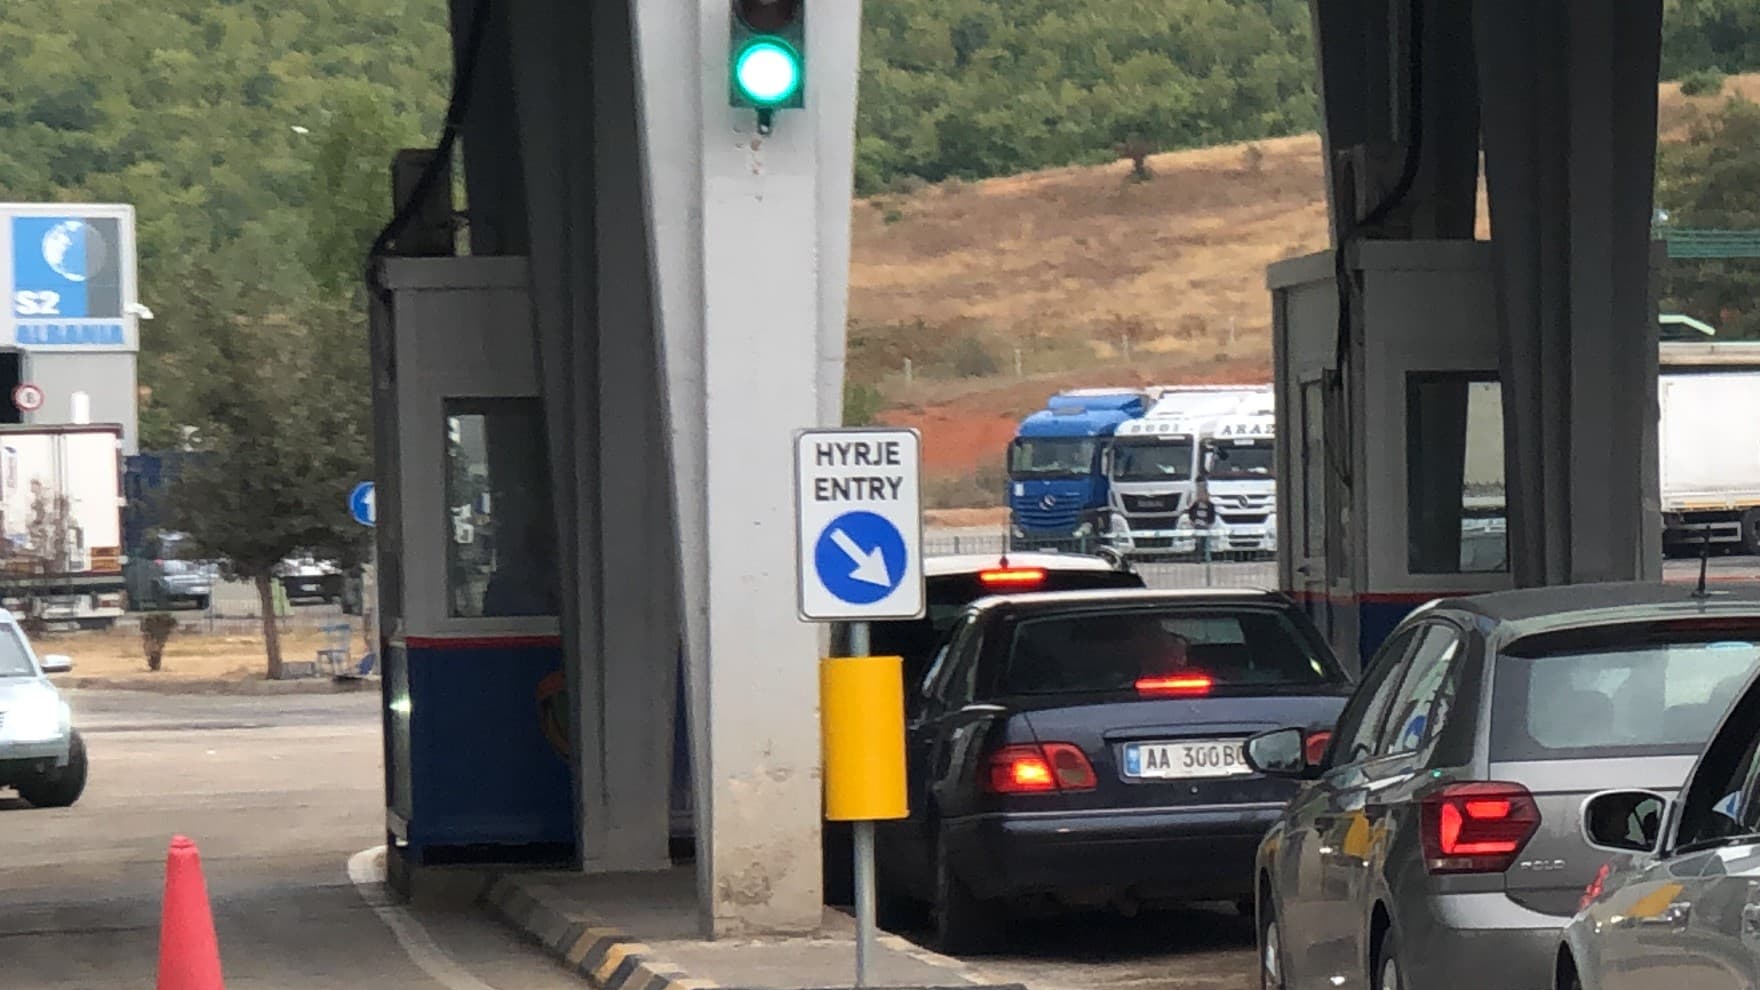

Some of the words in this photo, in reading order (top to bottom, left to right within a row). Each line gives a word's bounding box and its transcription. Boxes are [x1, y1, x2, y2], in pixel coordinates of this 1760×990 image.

[15, 290, 60, 315] S2
[815, 442, 901, 466] HYRJE
[814, 476, 904, 501] ENTRY
[1146, 748, 1171, 769] AA
